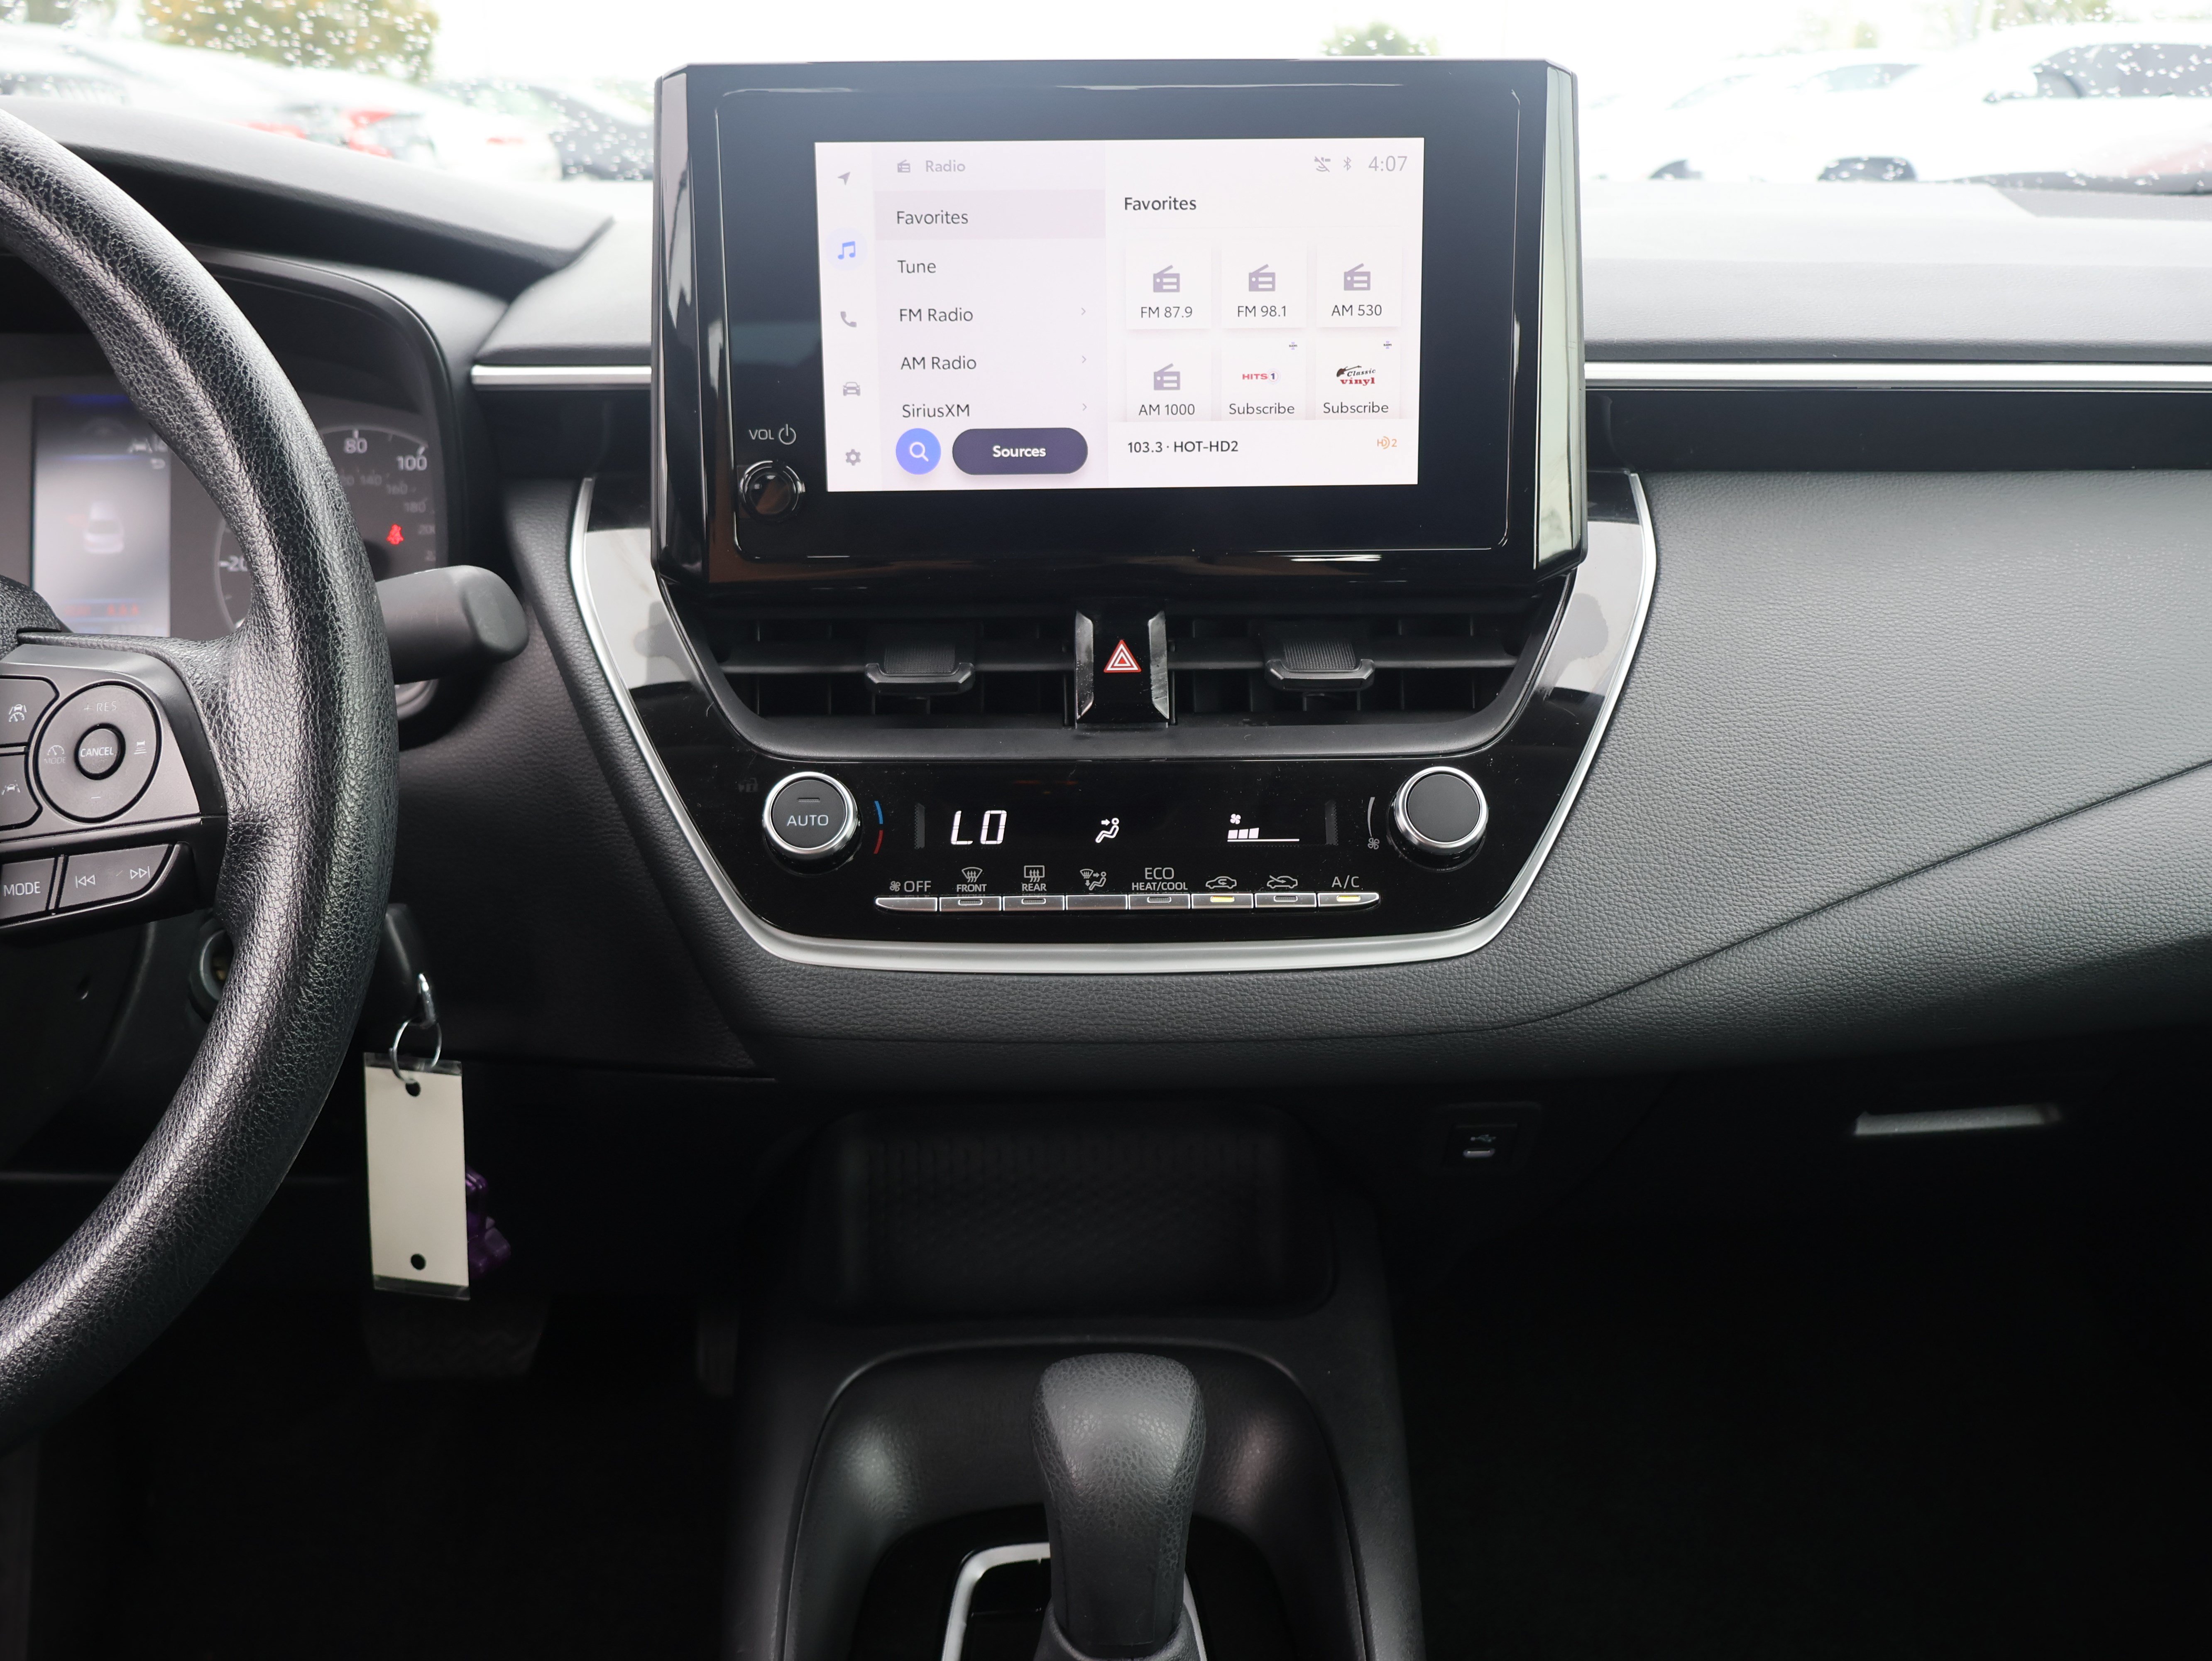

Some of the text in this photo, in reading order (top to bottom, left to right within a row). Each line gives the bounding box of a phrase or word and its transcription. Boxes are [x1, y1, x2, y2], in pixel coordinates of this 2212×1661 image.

[925, 159, 966, 172] Radio
[1368, 155, 1408, 172] 4:07
[1125, 196, 1197, 211] Favorites
[897, 210, 968, 225] Favorites
[897, 260, 936, 274] Tune
[900, 307, 973, 322] FM Radio
[1141, 306, 1193, 318] FM 87.9
[1238, 305, 1286, 317] FM 98.1
[1331, 304, 1382, 316] AM 530
[900, 355, 976, 370] AM Radio
[1347, 369, 1376, 377] Classic
[1340, 377, 1375, 386] vinyl
[902, 404, 969, 418] SiriusXM
[1138, 404, 1195, 416] AM 1000
[1229, 402, 1295, 415] Subscribe
[1323, 401, 1389, 414] Subscribe
[749, 429, 775, 440] VOL
[344, 438, 367, 453] 80
[993, 445, 1046, 458] Sources
[1128, 441, 1163, 453] 103.3
[1174, 441, 1238, 452] HOT-HD2
[396, 456, 428, 471] 100
[97, 701, 117, 712] RES
[80, 747, 114, 757] CANCEL
[787, 814, 829, 826] AUTO
[950, 810, 1007, 845] LO
[1145, 867, 1175, 880] ECO
[4, 881, 41, 896] MODE
[904, 880, 932, 892] OFF
[957, 884, 987, 892] FRONT
[1022, 883, 1047, 892] REAR
[1132, 881, 1188, 891] HEAT/COOL
[1331, 875, 1360, 889] A/C
